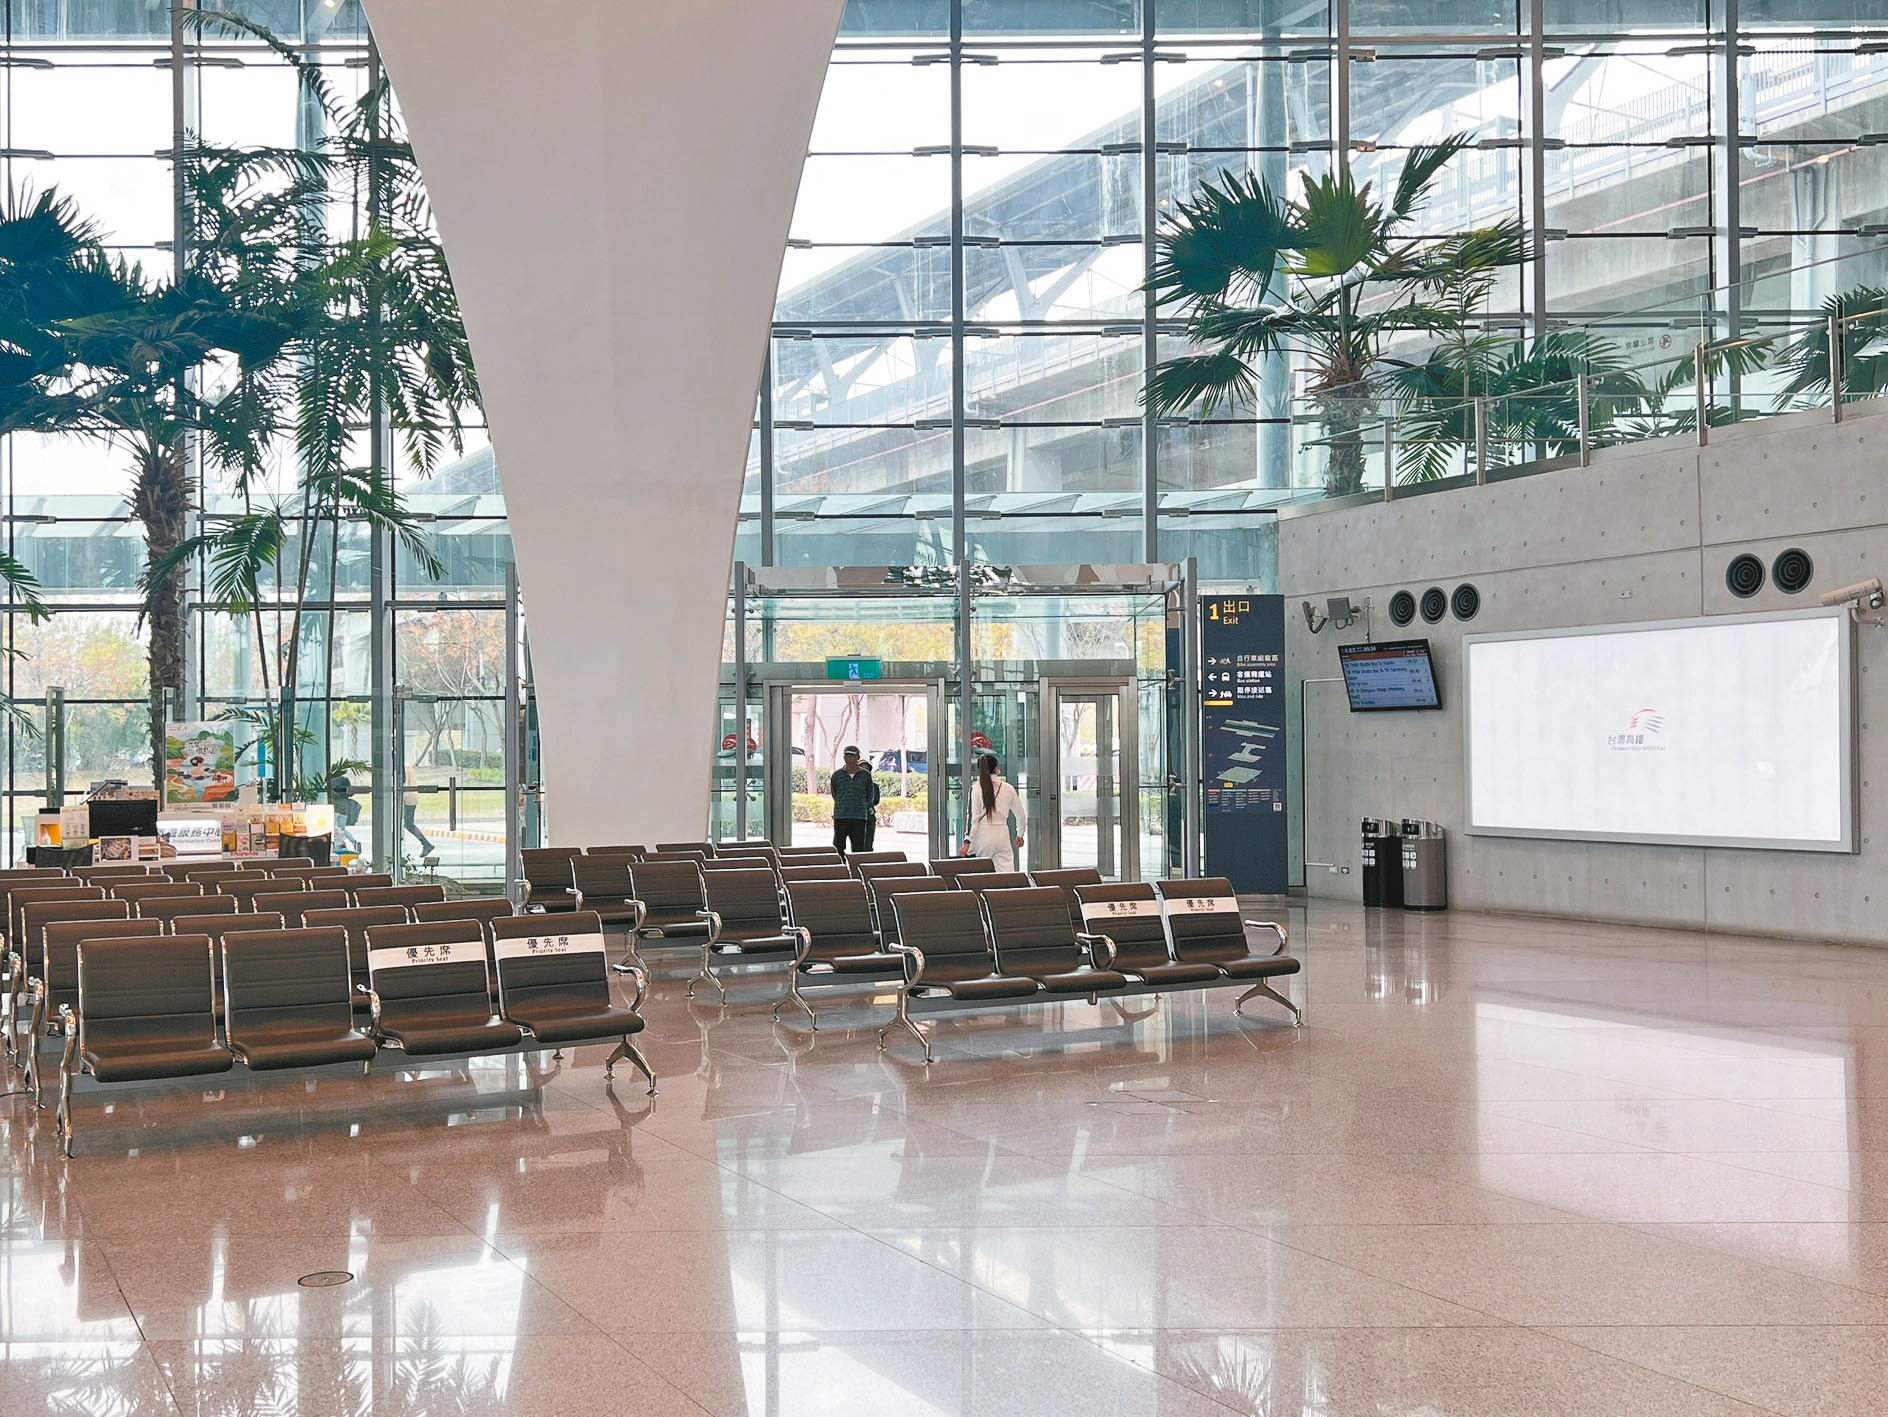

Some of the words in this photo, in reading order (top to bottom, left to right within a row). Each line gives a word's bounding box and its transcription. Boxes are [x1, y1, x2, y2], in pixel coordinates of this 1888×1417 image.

[1209, 603, 1219, 620] 1
[1223, 600, 1250, 614] 出口
[1223, 617, 1239, 625] Exit
[527, 936, 569, 949] 優先席
[407, 945, 451, 958] 優先席
